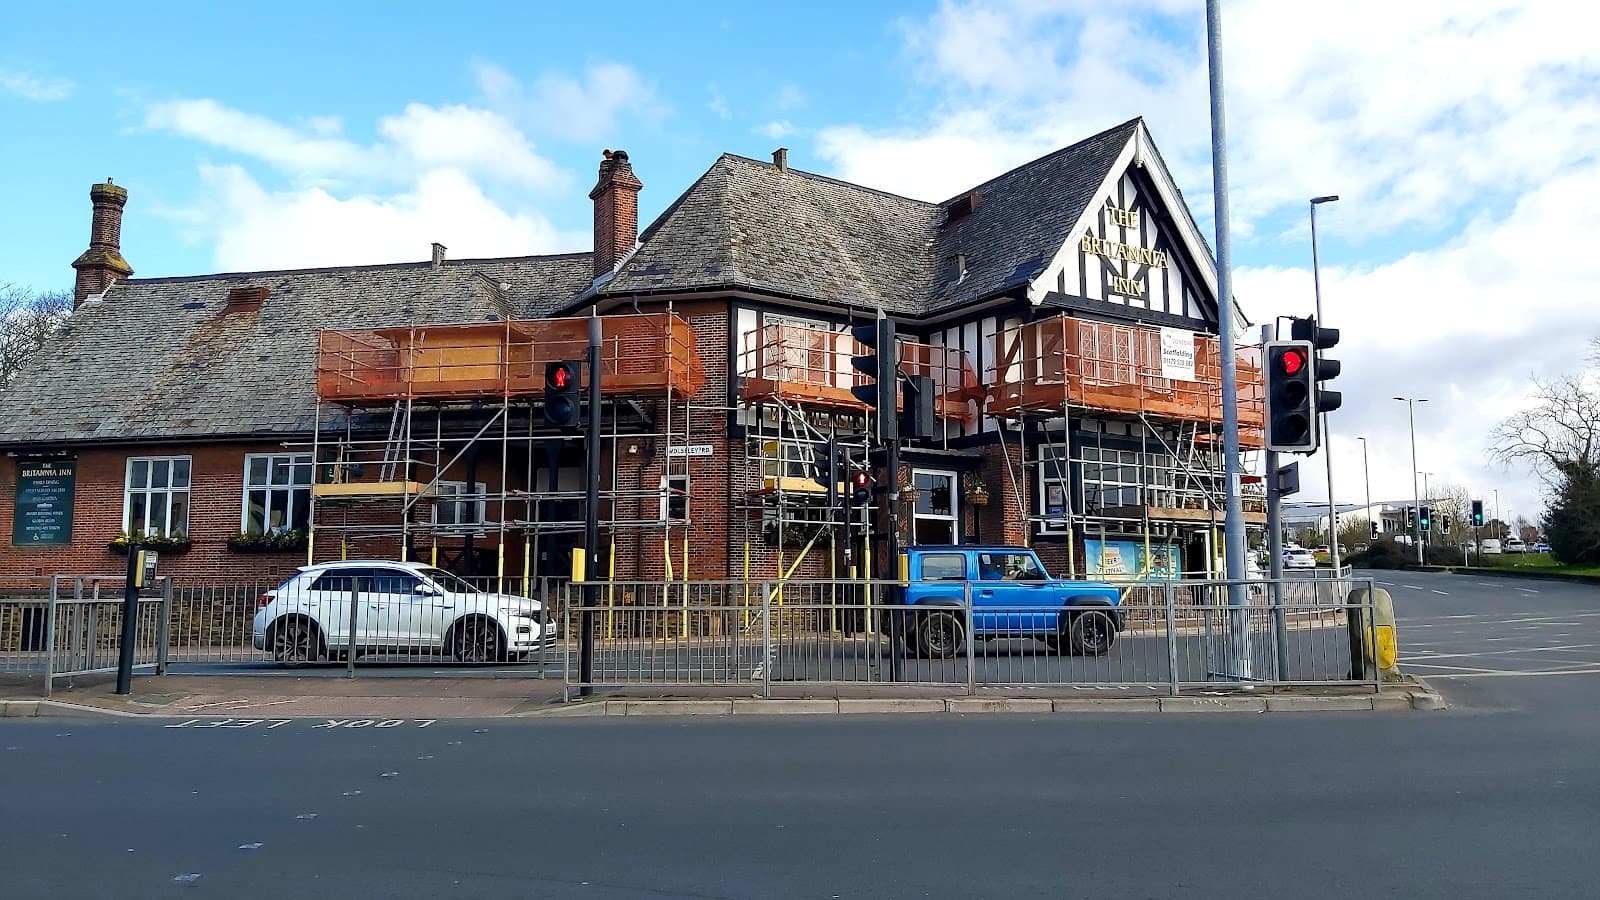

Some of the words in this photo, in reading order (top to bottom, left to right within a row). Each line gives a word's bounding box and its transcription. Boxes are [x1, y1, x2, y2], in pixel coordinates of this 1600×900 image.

[1107, 206, 1138, 229] THE
[1080, 233, 1169, 269] BRITANNIA
[1113, 275, 1143, 297] INN
[22, 469, 57, 478] BRITANNIA
[59, 469, 72, 477] INN
[1098, 567, 1122, 575] FSTIVAL
[163, 718, 293, 729] LEFT
[311, 718, 437, 729] LOOK
